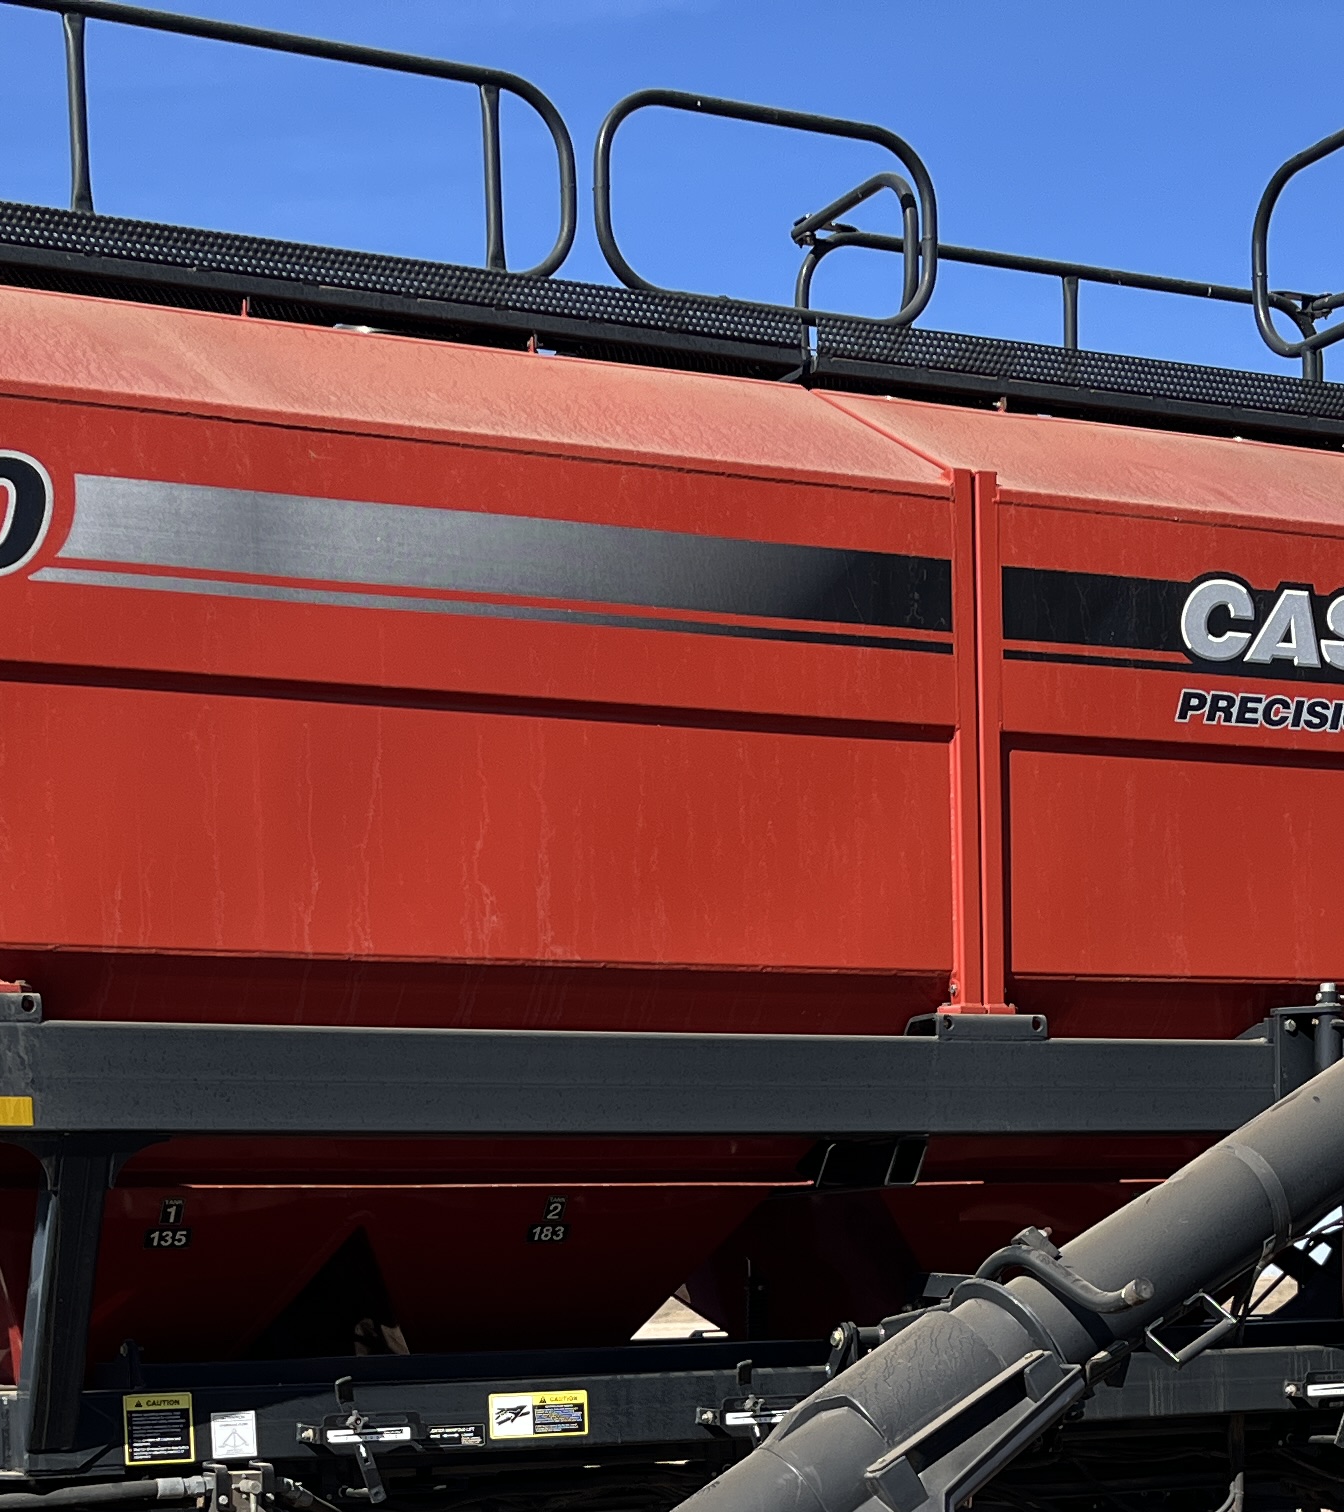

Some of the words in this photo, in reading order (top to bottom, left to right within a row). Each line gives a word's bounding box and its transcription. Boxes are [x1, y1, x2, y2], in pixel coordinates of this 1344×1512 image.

[166, 1205, 177, 1223] 1
[546, 1202, 562, 1220] 2
[150, 1230, 188, 1247] 135
[532, 1226, 565, 1241] 183
[145, 1399, 181, 1407] CAUTION
